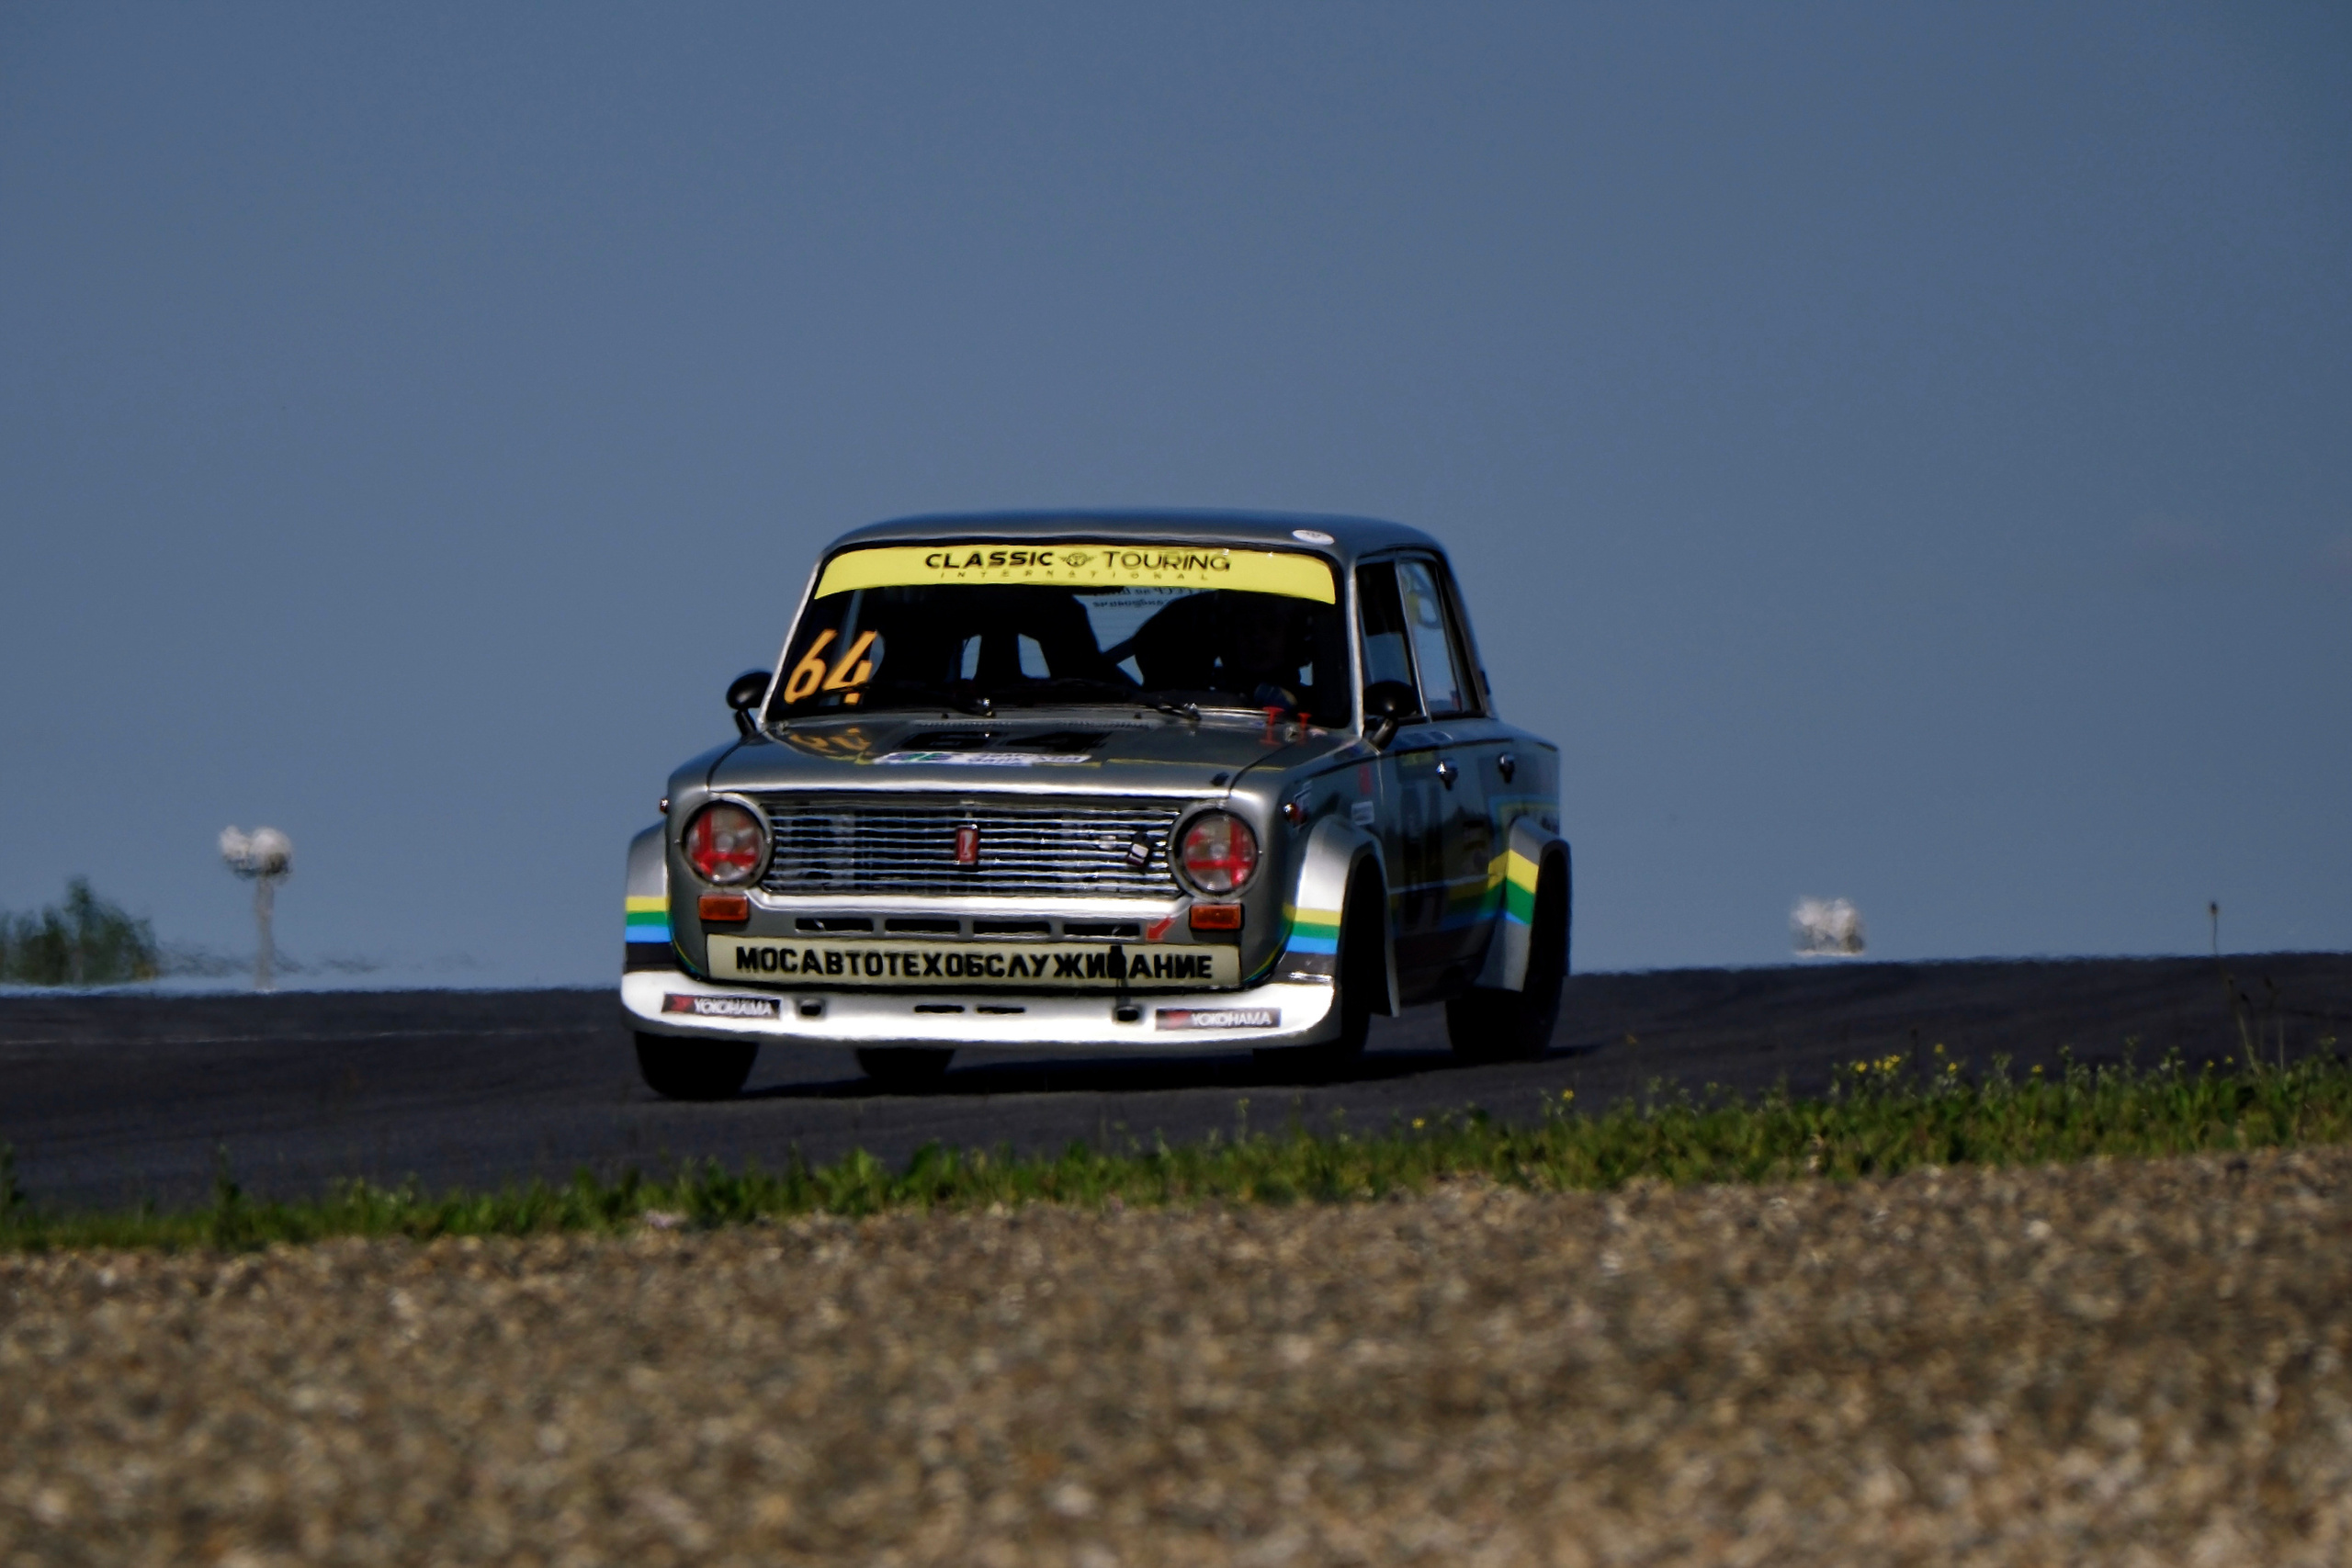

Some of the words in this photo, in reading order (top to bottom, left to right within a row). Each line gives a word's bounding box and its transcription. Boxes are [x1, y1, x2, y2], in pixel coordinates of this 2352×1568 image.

[925, 551, 1053, 569] CLASSIC
[1102, 551, 1230, 570] TOURING
[940, 570, 1208, 581] INTERNATIONAL
[784, 628, 876, 705] 64
[736, 946, 1213, 979] МОСАВТОТЕХОБСЛУЖИАНИЕ
[694, 998, 772, 1016] YOKOHAMA
[1192, 1012, 1272, 1026] YOKOHAMA
